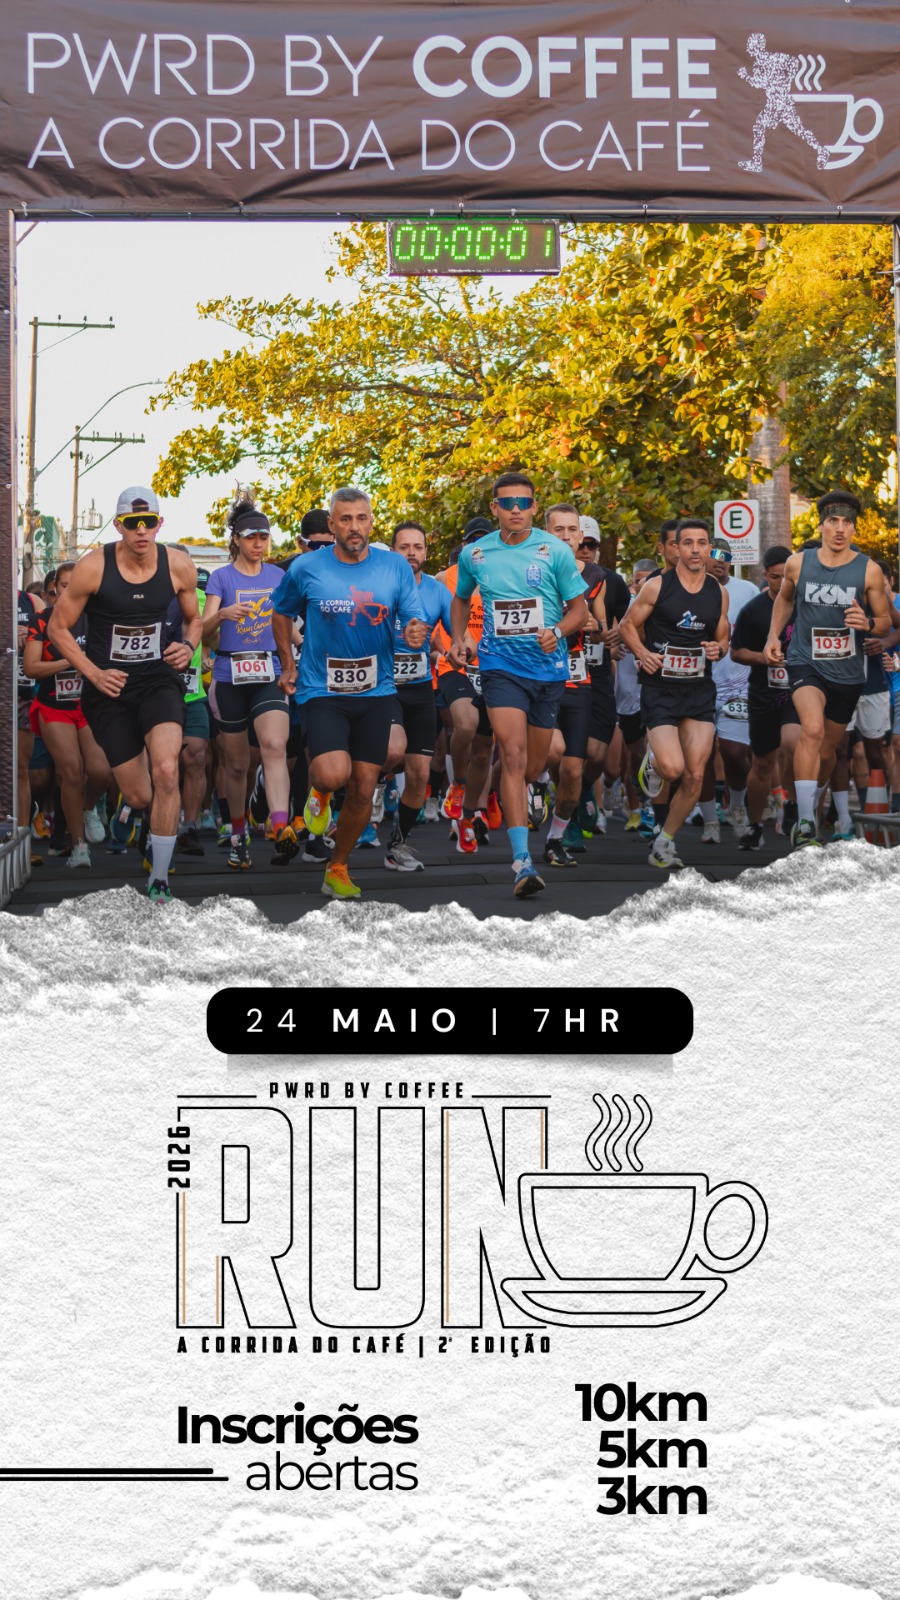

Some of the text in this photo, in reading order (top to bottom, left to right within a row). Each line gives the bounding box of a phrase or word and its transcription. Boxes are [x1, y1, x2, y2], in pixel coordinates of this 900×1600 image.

[27, 32, 717, 99] PWRD BY COFFEE
[27, 109, 711, 172] A CORRIDA DO CAFÉ
[395, 225, 552, 261] 00:00:01
[729, 510, 743, 529] E
[500, 610, 531, 626] 737
[119, 636, 151, 651] 782
[815, 636, 850, 650] 1037
[235, 660, 267, 673] 1061
[670, 656, 698, 669] 1121
[333, 669, 367, 684] 830
